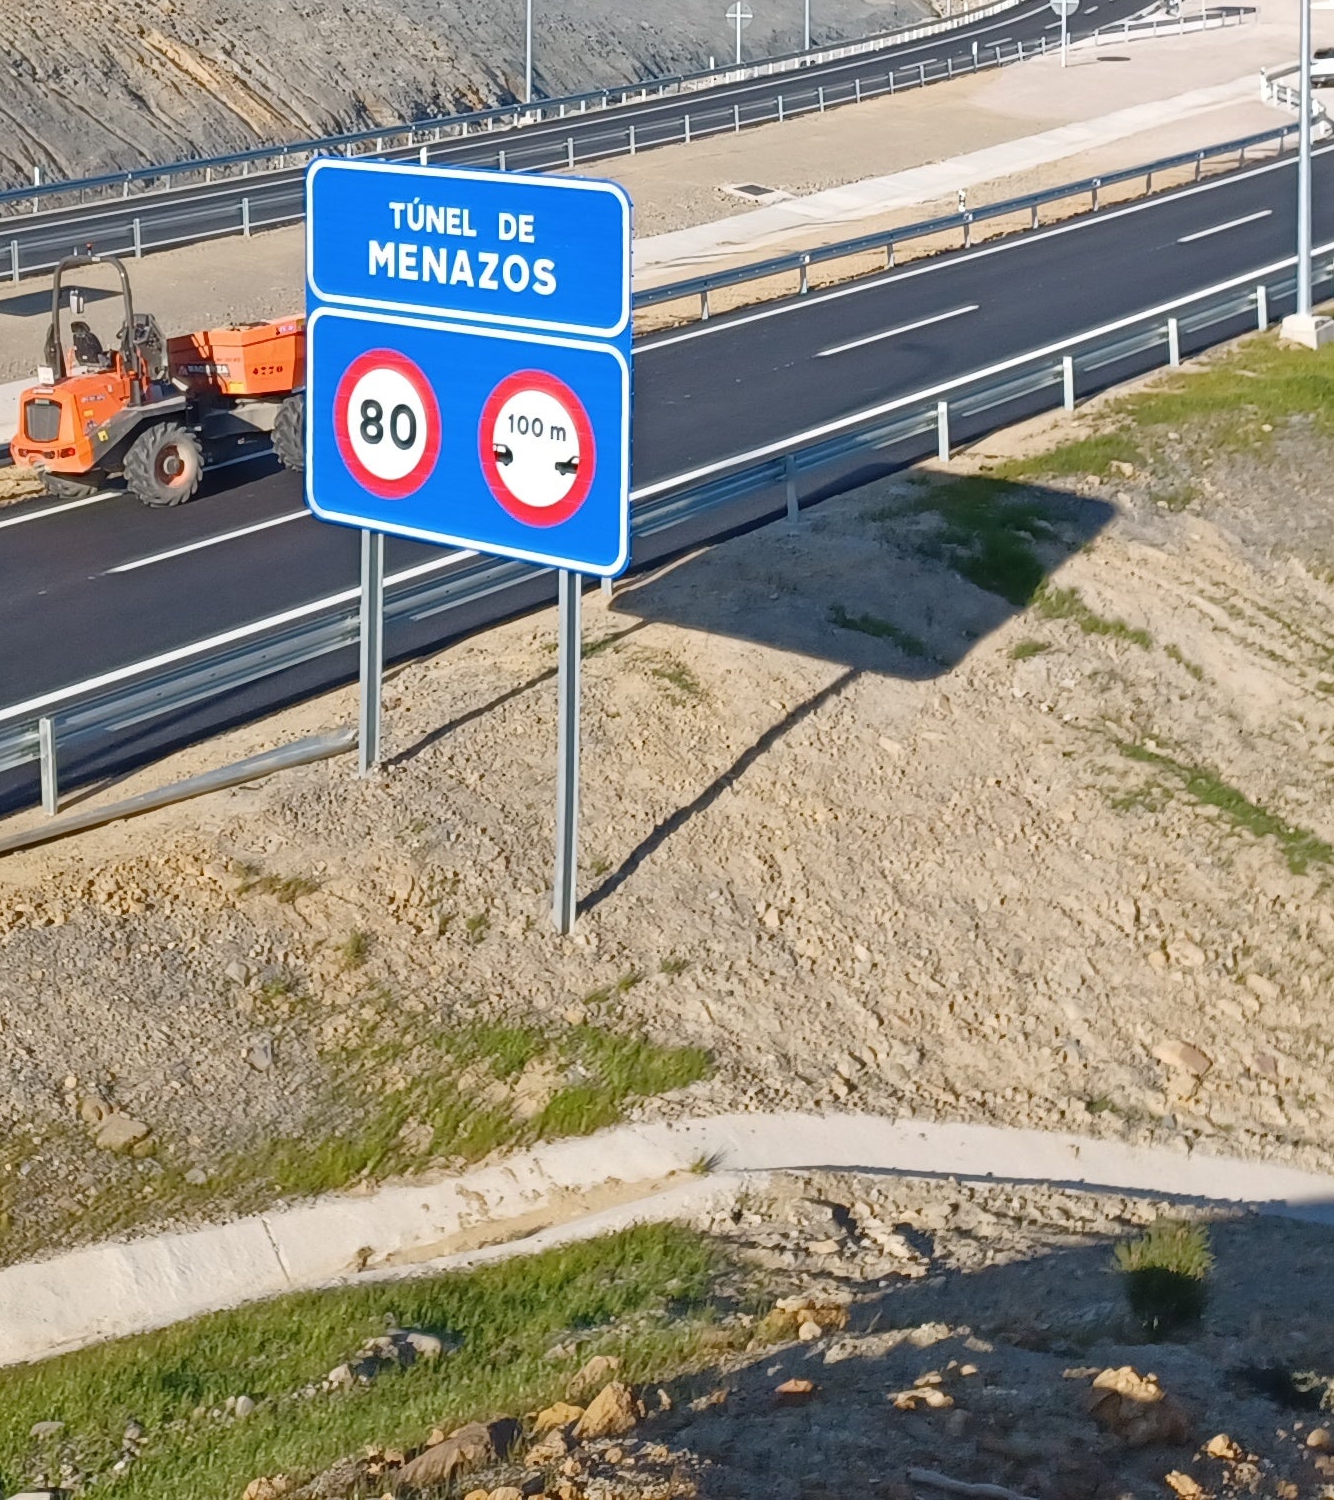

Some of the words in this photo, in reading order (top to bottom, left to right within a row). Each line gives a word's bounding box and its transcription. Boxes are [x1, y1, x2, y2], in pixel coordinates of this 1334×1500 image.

[388, 197, 477, 237] TÚNEL
[498, 212, 535, 243] DE
[368, 240, 557, 295] MENAZOS
[360, 399, 417, 450] 80
[508, 414, 544, 437] 100
[550, 425, 567, 441] m
